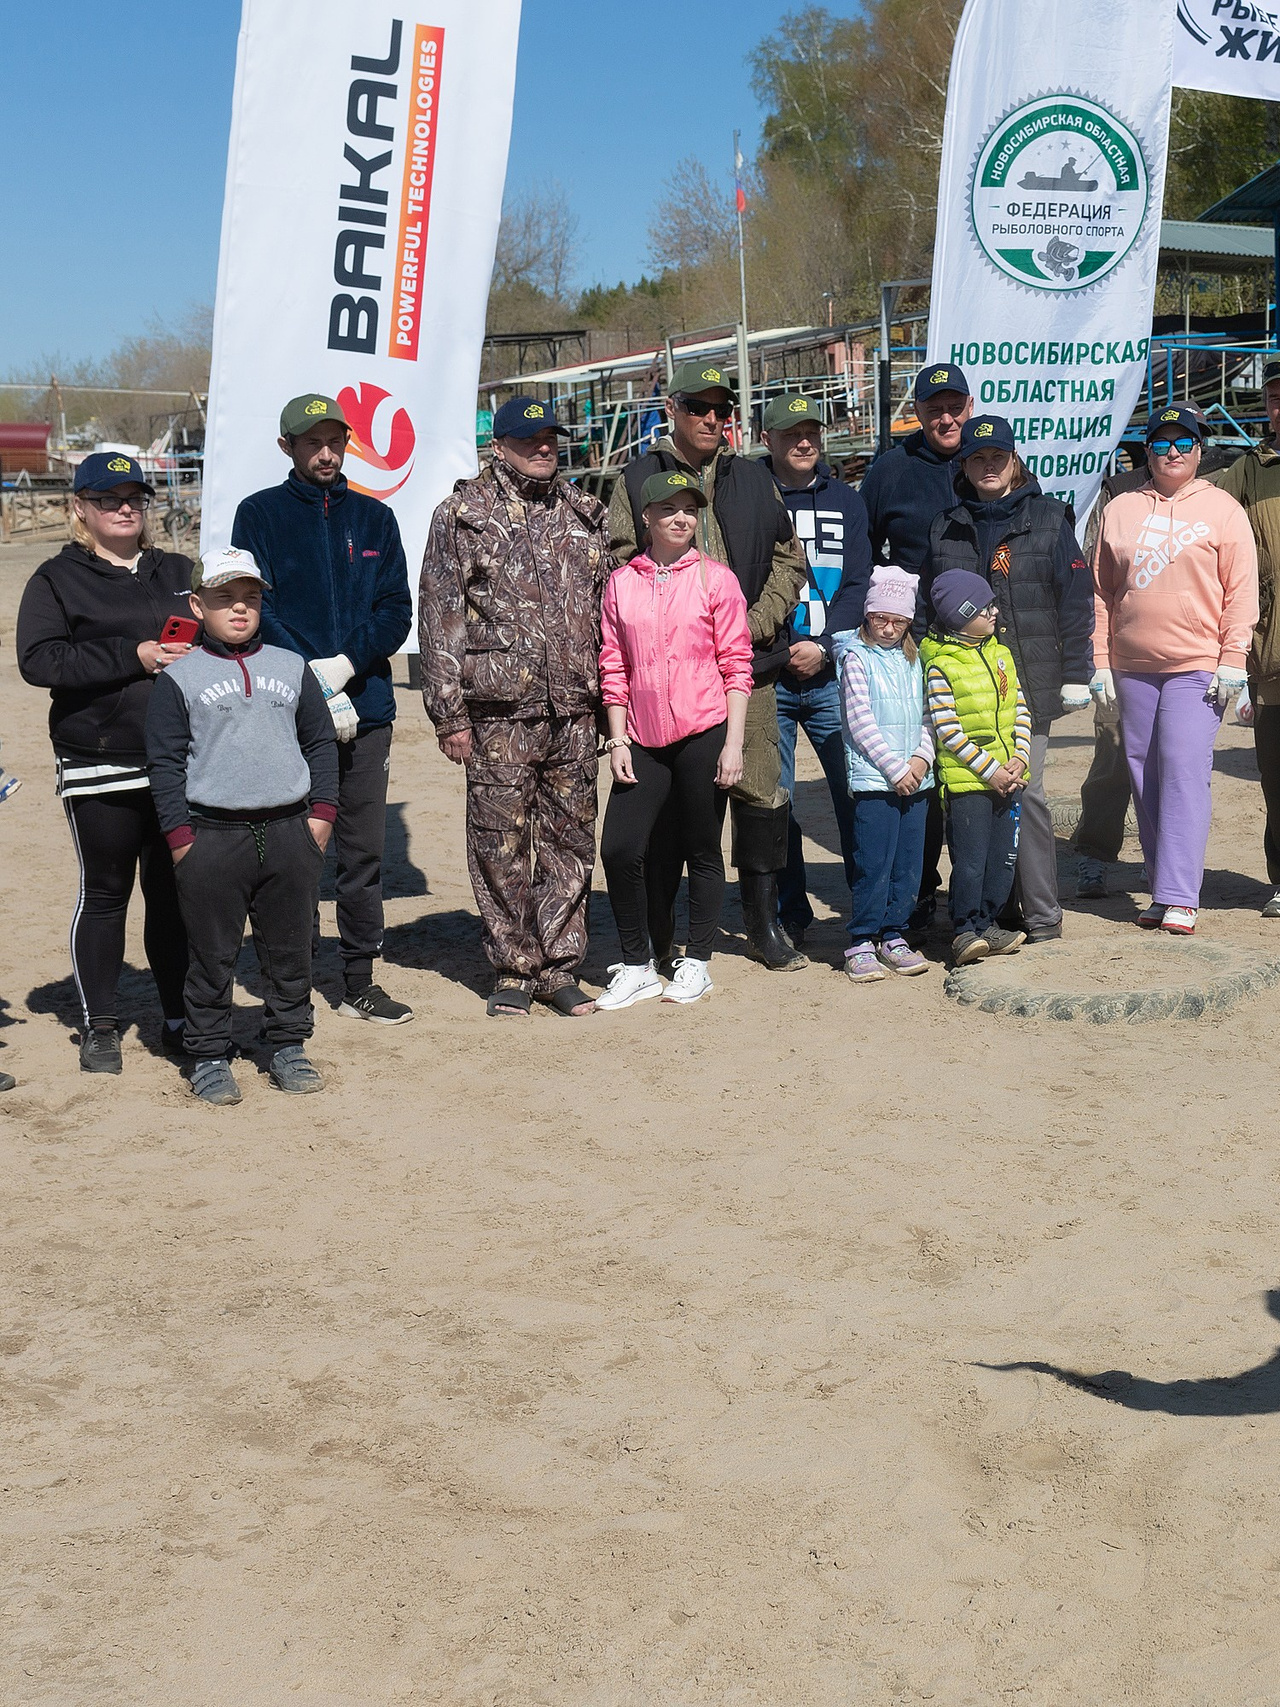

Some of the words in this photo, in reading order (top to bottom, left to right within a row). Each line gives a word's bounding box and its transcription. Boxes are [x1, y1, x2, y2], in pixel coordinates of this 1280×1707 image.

[407, 39, 437, 213] TECHNOLOGIES
[991, 113, 1083, 181] НОВОСИБИРСКАЯ
[1084, 121, 1130, 184] ОБЛАСТНАЯ
[328, 19, 403, 355] BAIKAL
[1007, 202, 1111, 221] ФЕДЕРАЦИЯ
[992, 224, 1083, 235] РЫБОЛОВНОГО
[1086, 226, 1124, 237] СПОРТА
[396, 221, 422, 346] POWERFUL
[950, 337, 1150, 366] НОВОСИБИРСКАЯ
[980, 379, 1115, 404] ОБЛАСТНАЯ
[1012, 414, 1112, 444] ДЕРАЦИЯ
[1025, 451, 1110, 478] ЛОВНОГ
[1135, 521, 1210, 589] adidas
[200, 678, 240, 706] #REAL
